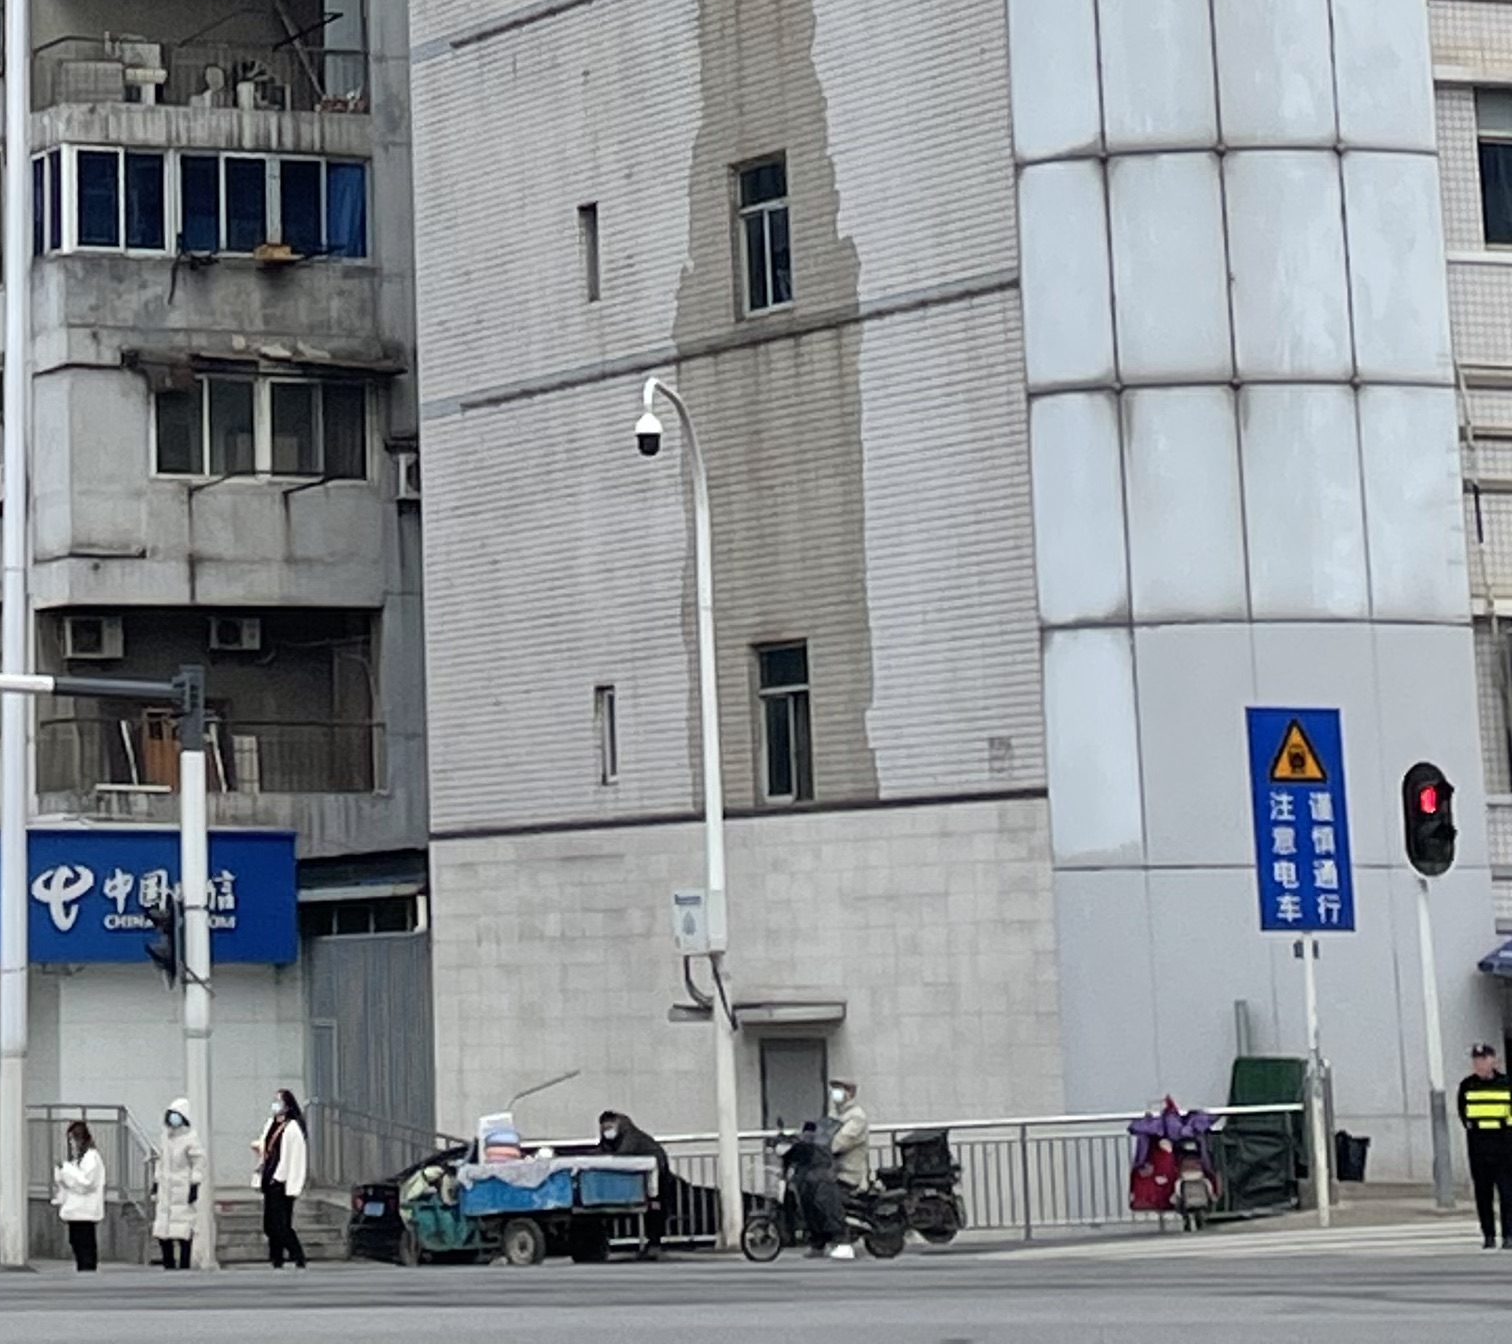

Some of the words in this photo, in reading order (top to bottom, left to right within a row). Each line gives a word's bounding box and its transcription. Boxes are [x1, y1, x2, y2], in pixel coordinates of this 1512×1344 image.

[102, 867, 236, 913] 中国信
[1269, 791, 1303, 923] 注意电车
